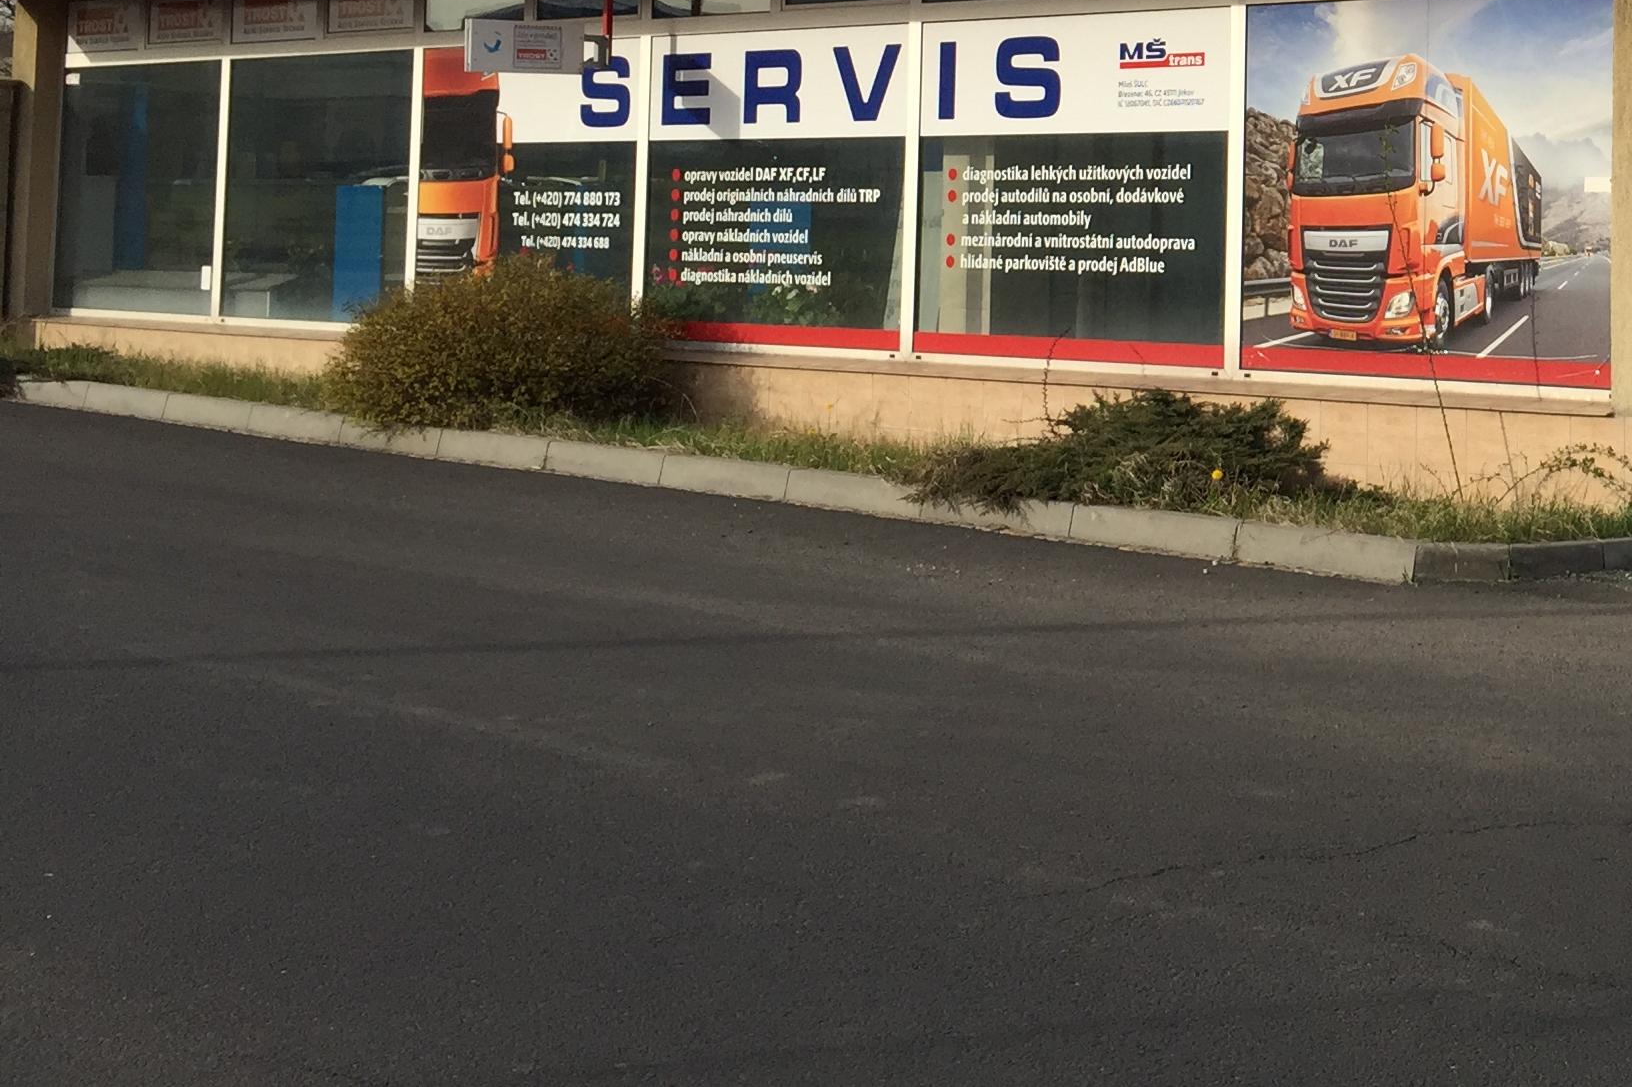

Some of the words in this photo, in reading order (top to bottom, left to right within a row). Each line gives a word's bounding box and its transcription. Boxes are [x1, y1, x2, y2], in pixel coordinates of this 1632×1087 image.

[1119, 38, 1167, 60] MŠ
[1168, 54, 1203, 67] trans
[580, 35, 1062, 128] SERVIS
[1328, 67, 1376, 92] XF
[684, 170, 717, 184] opravy
[718, 167, 754, 182] vozidel
[755, 167, 777, 181] DAF
[778, 167, 826, 183] XF,CF,LF
[962, 165, 1029, 183] diagnostika
[1030, 164, 1077, 182] lehkých
[1078, 164, 1144, 182] užitkových
[1146, 164, 1192, 180] vozidel
[1478, 147, 1509, 206] XF
[513, 191, 530, 206] Tel.
[532, 190, 563, 208] (+420)
[563, 192, 581, 206] 774
[582, 192, 602, 206] 880
[604, 191, 621, 206] 173
[683, 188, 715, 204] prodej
[716, 187, 775, 203] originálních
[776, 188, 833, 203] náhradních
[836, 188, 857, 203] dílů
[858, 189, 881, 203] TRP
[961, 188, 999, 206] prodej
[1001, 187, 1050, 204] autodílů
[1052, 191, 1067, 204] na
[1069, 188, 1114, 206] osobní,
[1115, 187, 1184, 204] dodávkové
[512, 212, 530, 227] Tel.
[531, 212, 561, 229] (+420)
[562, 213, 581, 228] 474
[582, 213, 601, 228] 334
[602, 213, 620, 228] 724
[682, 208, 715, 224] prodej
[715, 208, 772, 223] náhradních
[962, 214, 969, 225] a
[971, 210, 1022, 225] nákladní
[1023, 210, 1092, 229] automobily
[426, 226, 452, 236] DAF
[682, 230, 715, 245] opravy
[716, 228, 770, 244] nákladních
[771, 229, 809, 244] vozidel
[521, 235, 535, 248] Tel.
[561, 236, 577, 248] 474
[577, 236, 592, 248] 334
[961, 232, 1033, 248] mezinárodní
[1035, 238, 1042, 248] a
[1043, 233, 1114, 249] vnitrostátní
[1115, 235, 1196, 253] autodoprava
[1328, 238, 1359, 249] DAF
[681, 248, 723, 262] nákladní
[725, 252, 731, 262] a
[732, 249, 766, 263] osobní
[767, 250, 823, 266] pneuservis
[960, 254, 1003, 270] hlídané
[1005, 255, 1067, 274] parkoviště
[1069, 261, 1076, 272] a
[1077, 257, 1118, 276] prodej
[1119, 257, 1165, 274] AdBlue
[680, 268, 737, 285] diagnostika
[737, 269, 793, 284] nákladních
[794, 270, 831, 286] vozidel
